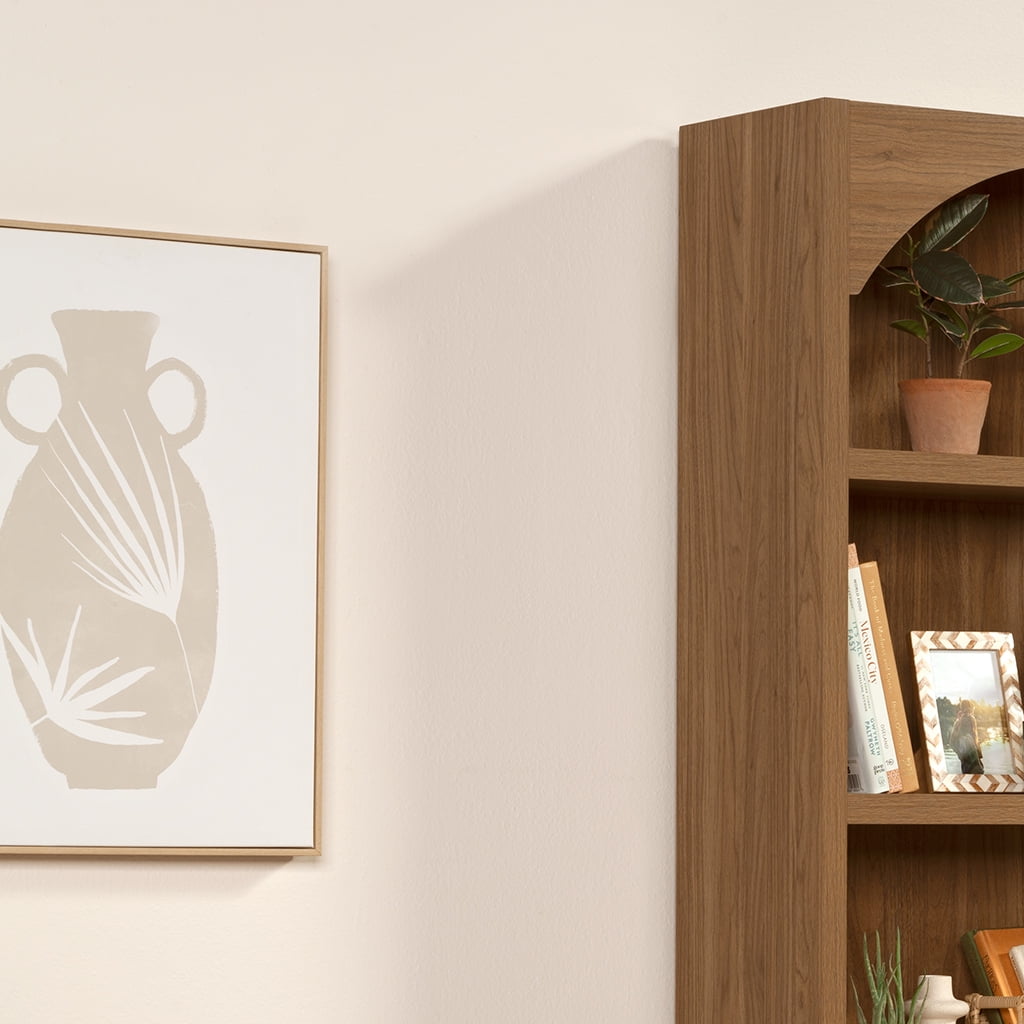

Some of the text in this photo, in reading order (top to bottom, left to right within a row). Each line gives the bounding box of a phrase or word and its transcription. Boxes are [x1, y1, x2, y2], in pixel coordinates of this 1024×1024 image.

[860, 620, 877, 684] Mexico City
[865, 720, 876, 756] PALTROW
